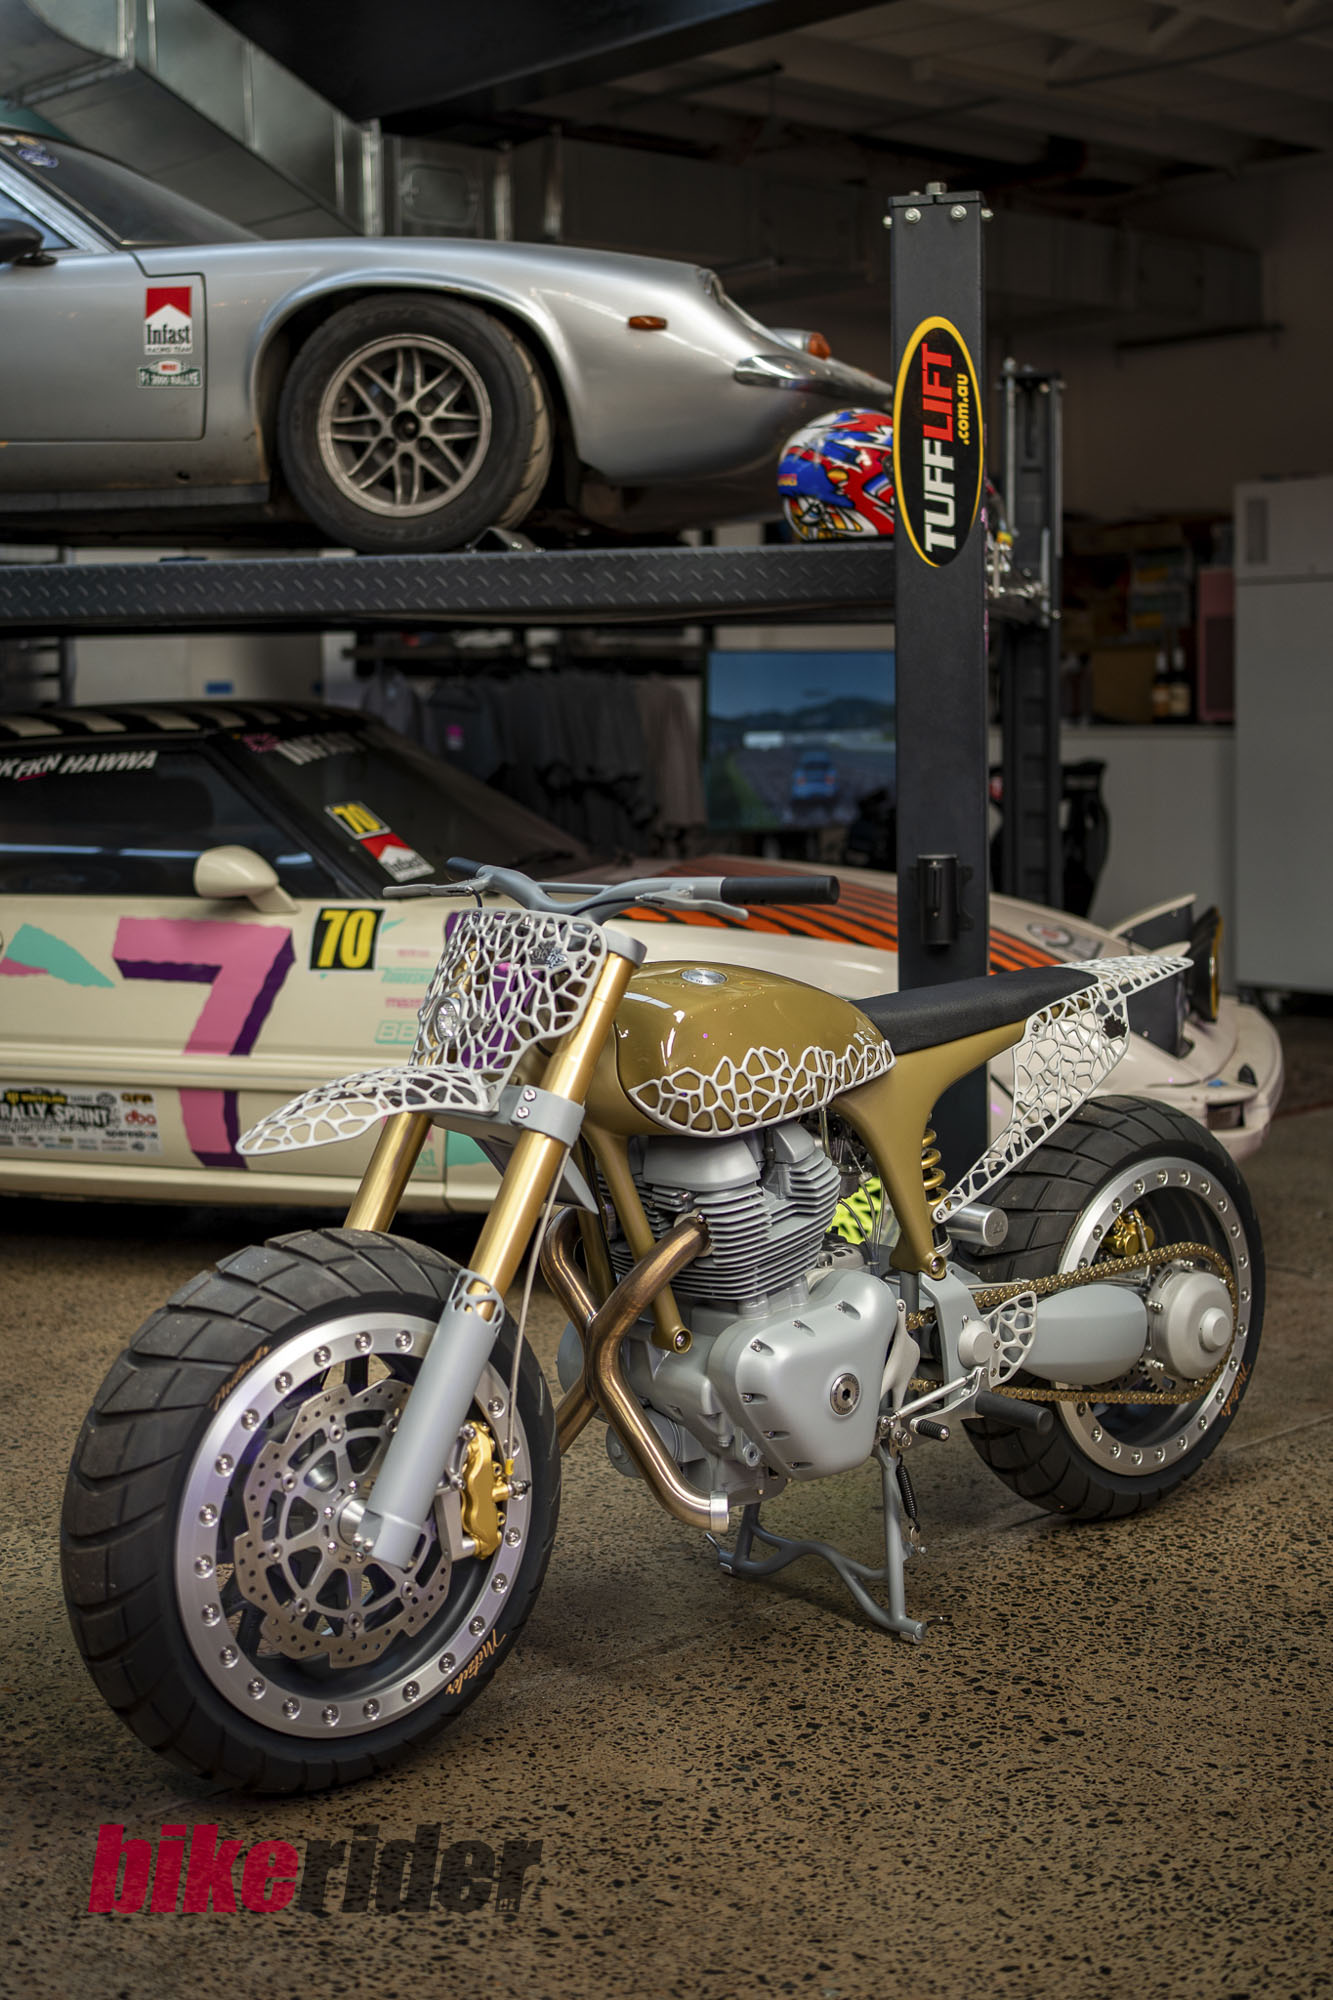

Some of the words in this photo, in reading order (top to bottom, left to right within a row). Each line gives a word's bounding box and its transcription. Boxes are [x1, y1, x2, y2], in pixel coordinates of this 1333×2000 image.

[146, 323, 190, 345] Infast
[957, 373, 970, 446] .com.au
[921, 342, 957, 552] TUFFLIFT
[58, 750, 159, 775] HAWWA
[332, 803, 380, 835] 70
[317, 910, 377, 969] 70
[0, 1103, 48, 1121] RALLY
[53, 1104, 110, 1127] SPRINT
